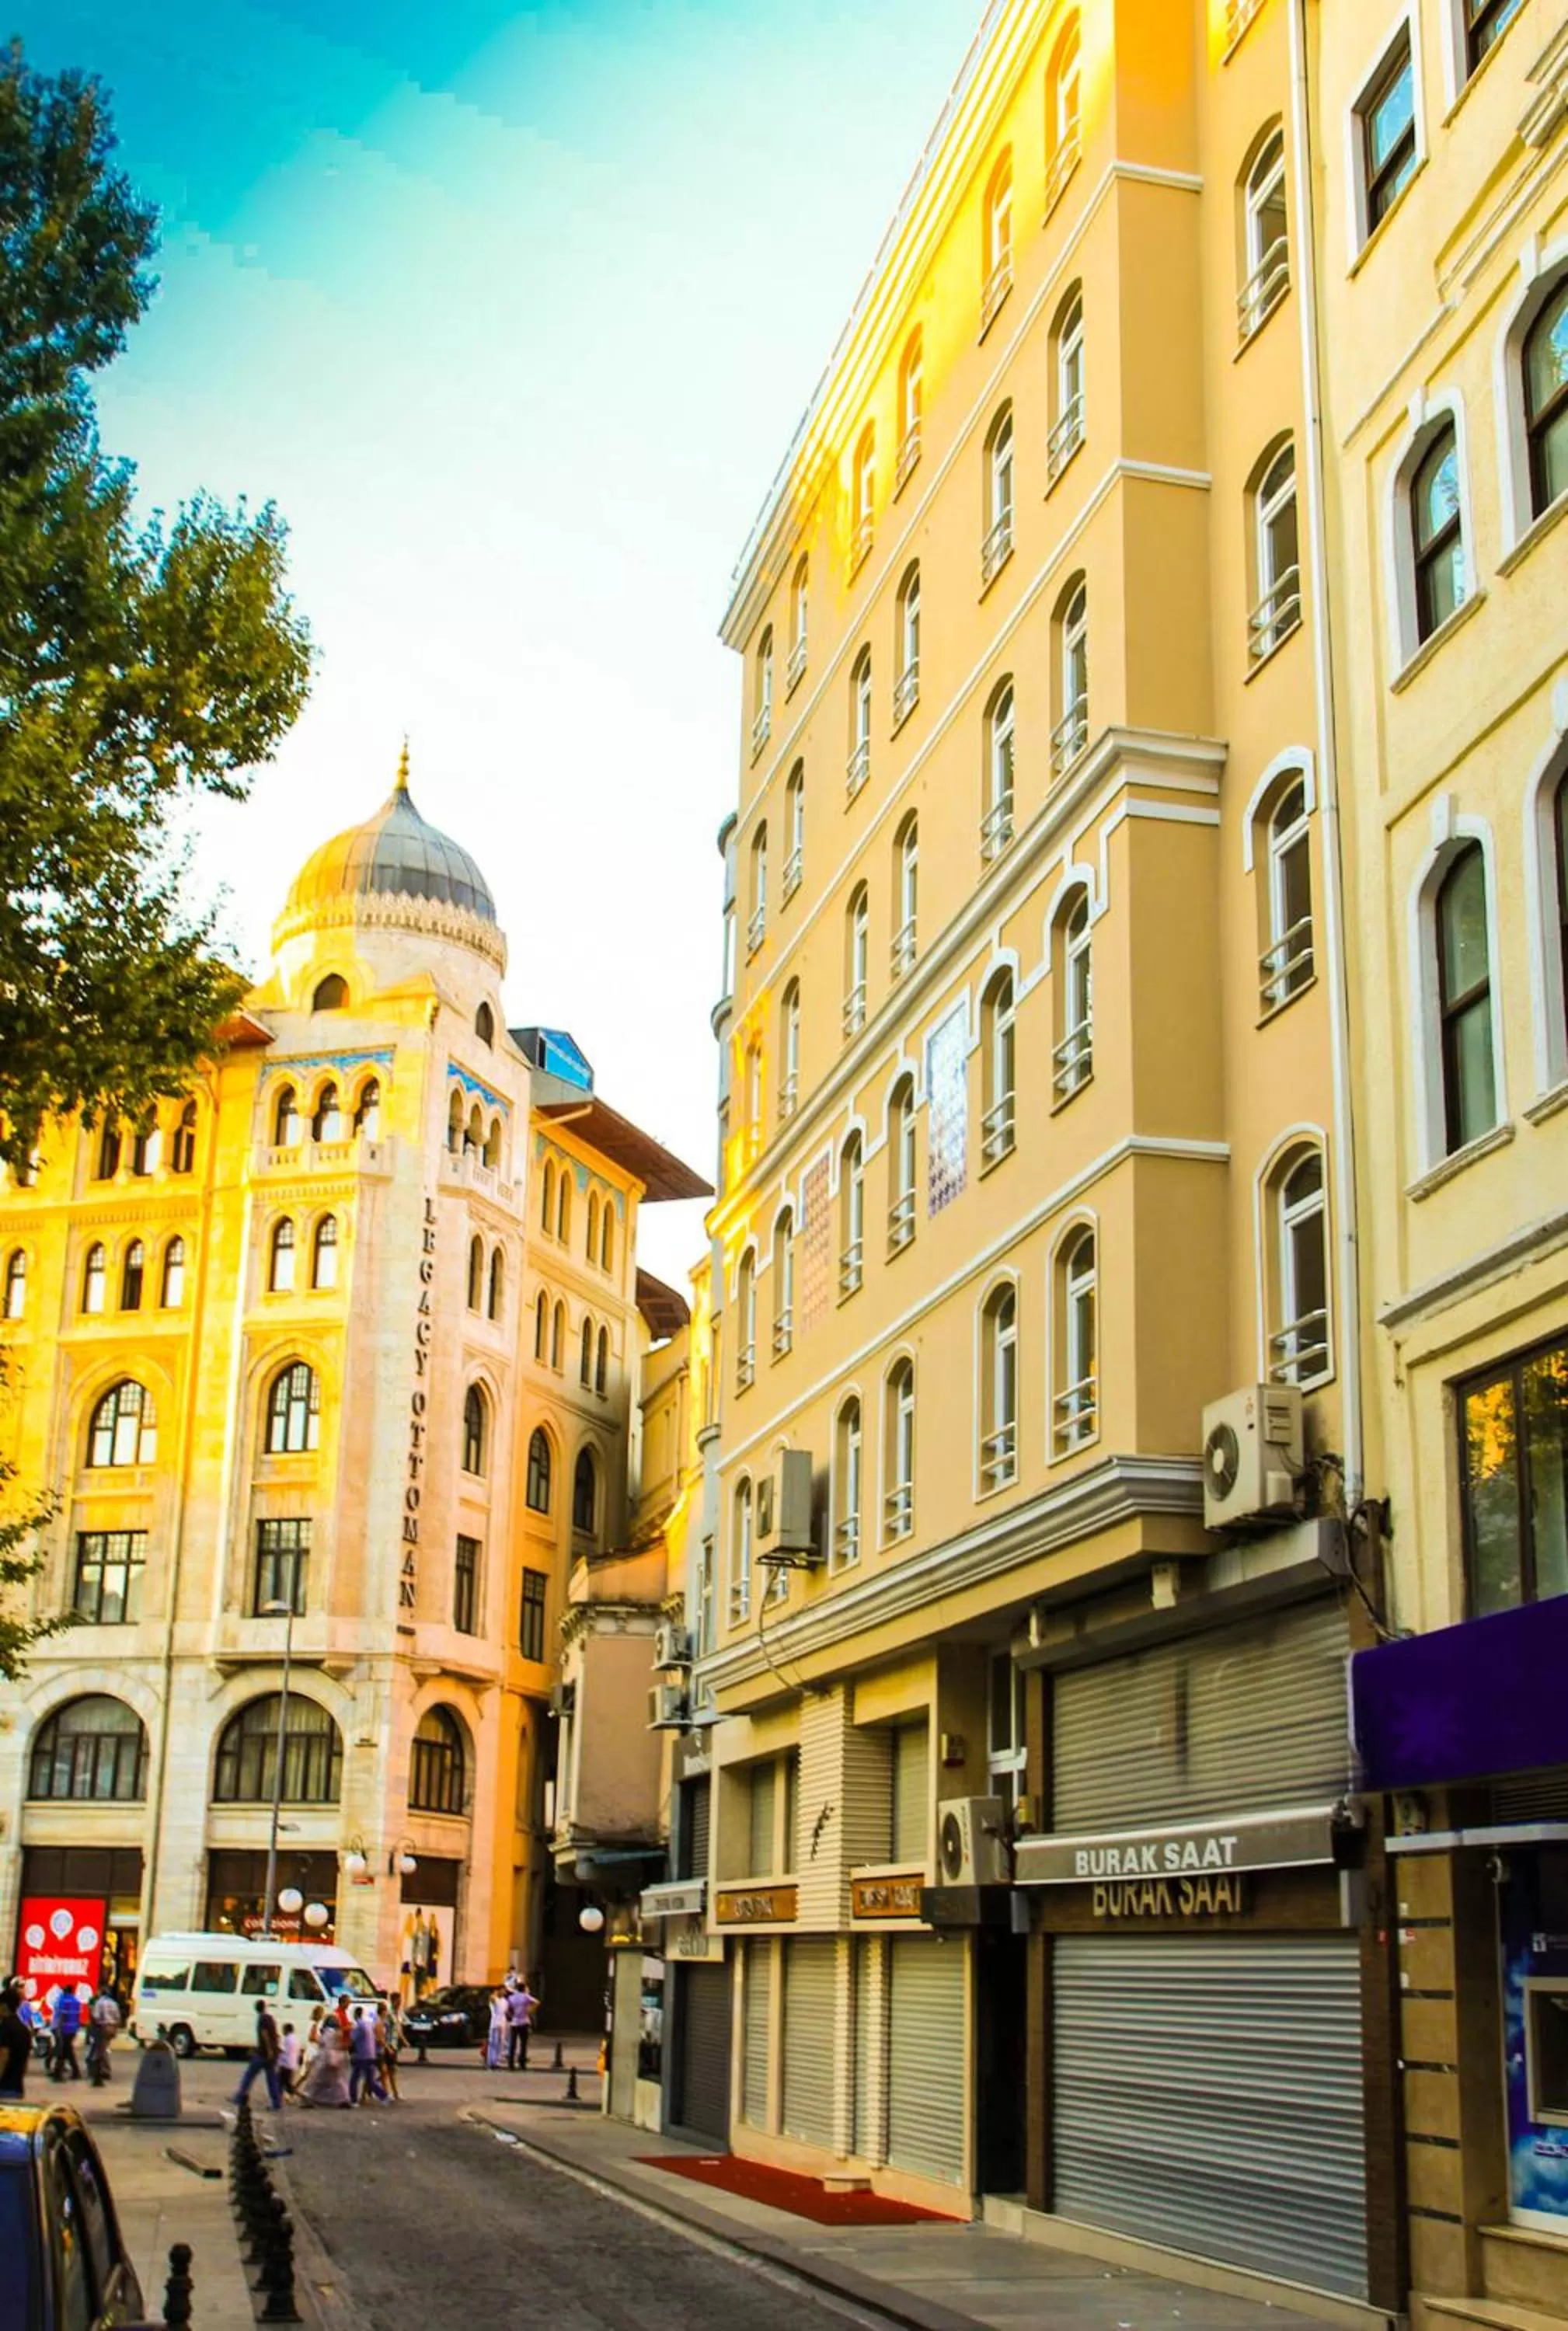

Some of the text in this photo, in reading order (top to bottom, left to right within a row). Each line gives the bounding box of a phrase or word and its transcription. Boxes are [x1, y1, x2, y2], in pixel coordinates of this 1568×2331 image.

[398, 1197, 436, 1608] LEGACY OTTOMAN
[1075, 1836, 1238, 1876] BURAK SAAT
[1093, 1874, 1241, 1916] BURAK SAAT
